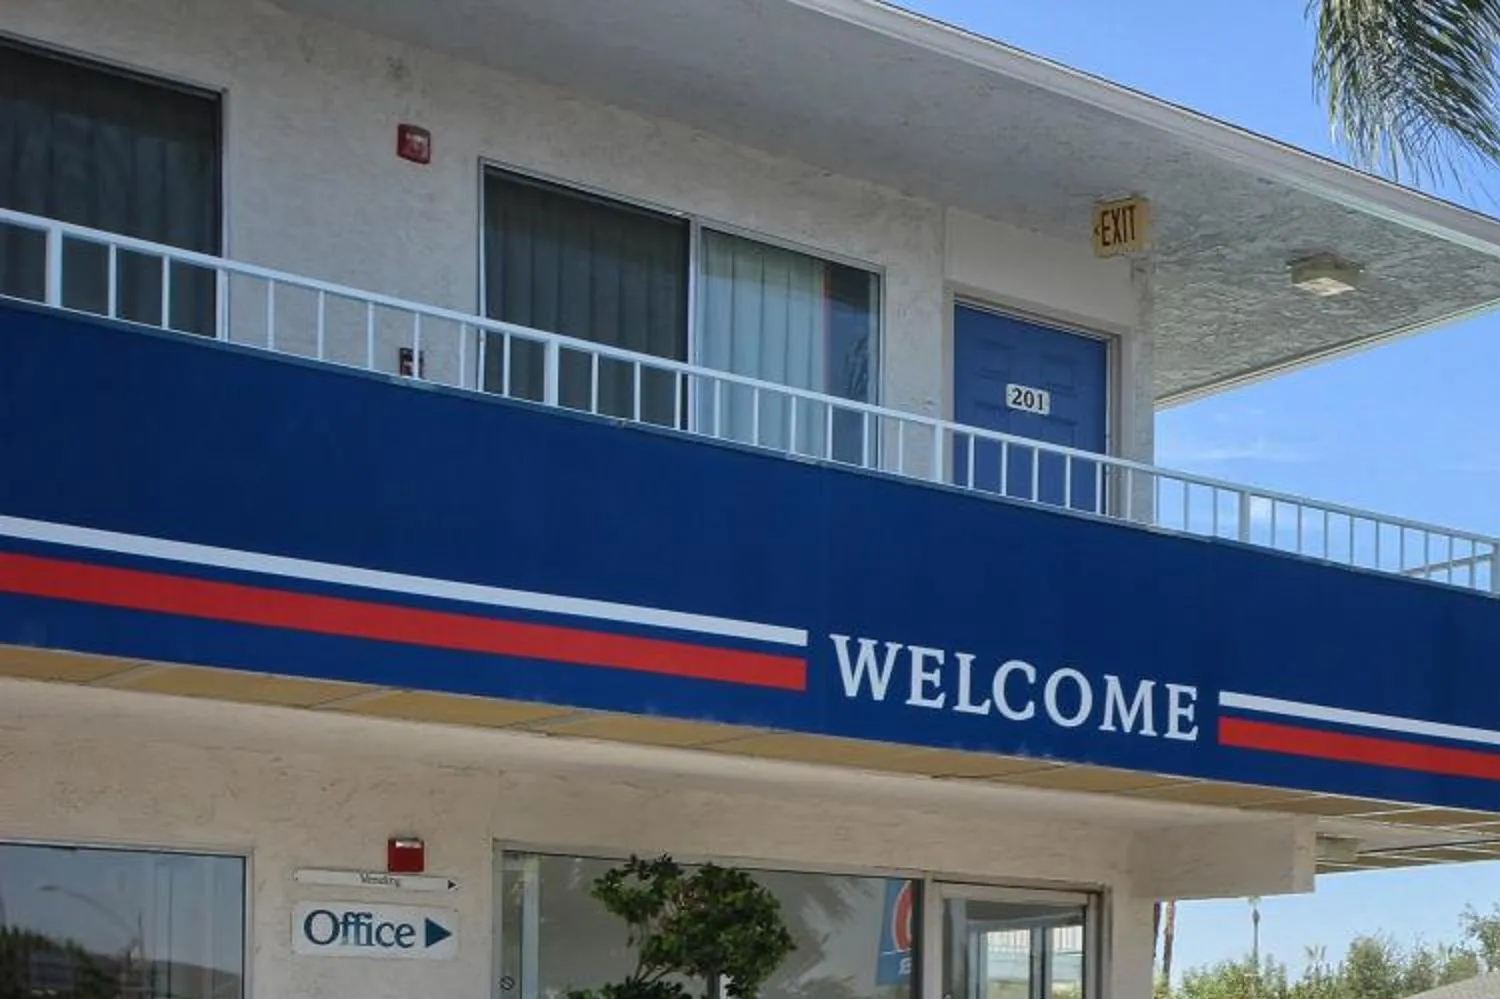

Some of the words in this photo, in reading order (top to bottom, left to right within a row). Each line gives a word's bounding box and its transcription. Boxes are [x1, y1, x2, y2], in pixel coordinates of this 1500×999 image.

[1101, 204, 1137, 247] EXIT
[1010, 386, 1046, 412] 201
[829, 633, 1200, 742] WELCOME
[359, 870, 401, 889] Vending
[303, 909, 416, 949] Office
